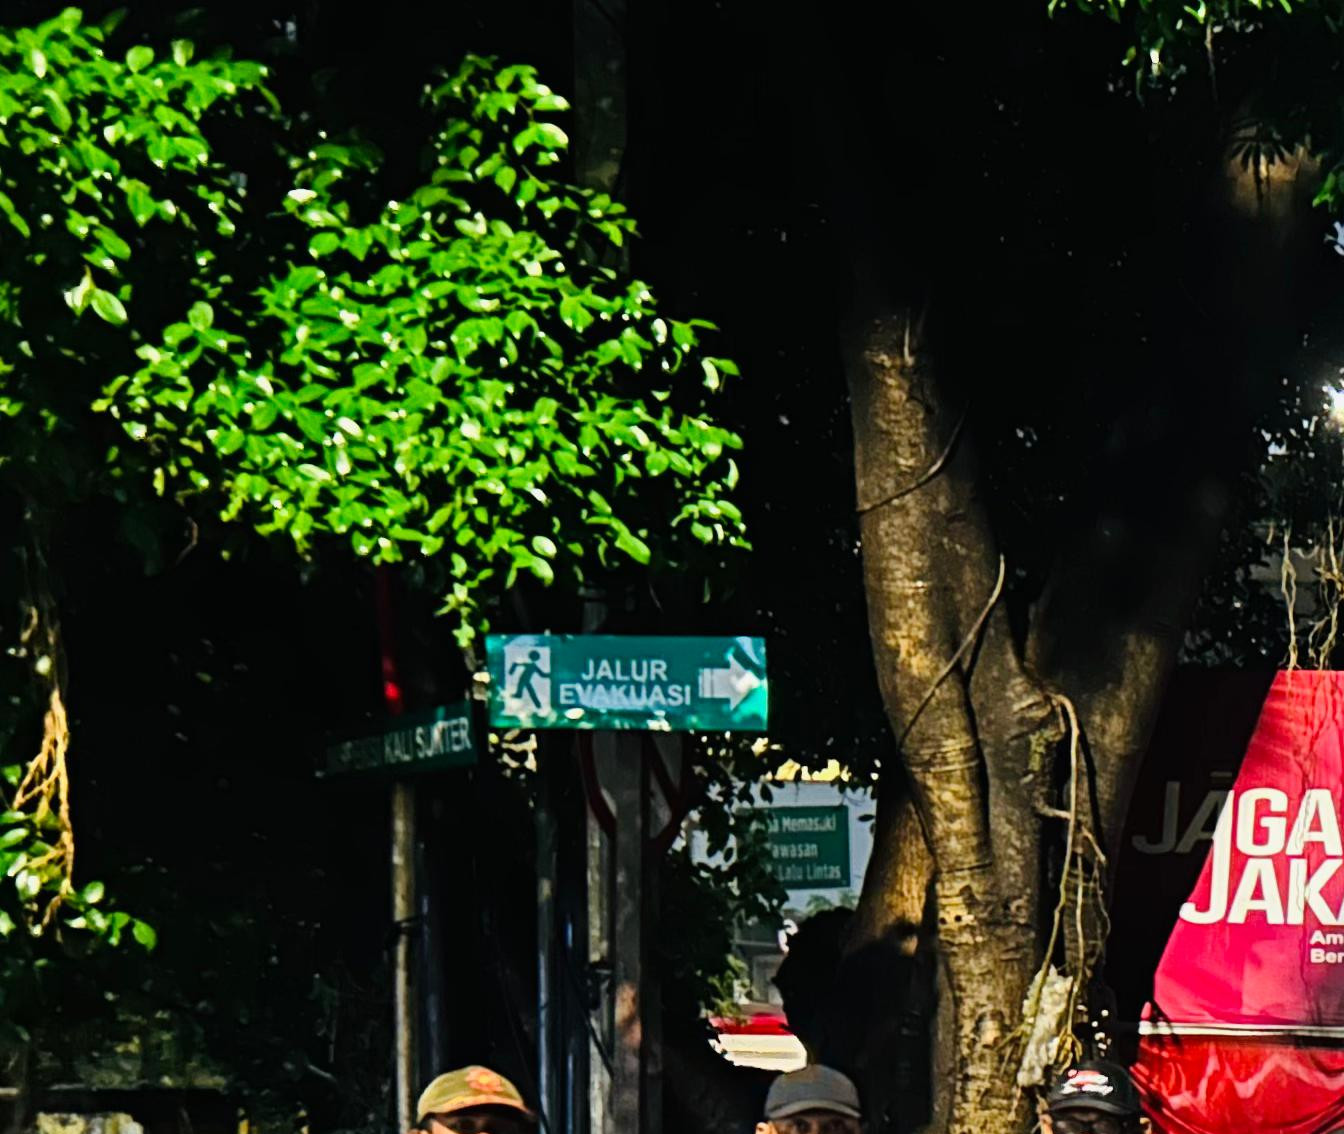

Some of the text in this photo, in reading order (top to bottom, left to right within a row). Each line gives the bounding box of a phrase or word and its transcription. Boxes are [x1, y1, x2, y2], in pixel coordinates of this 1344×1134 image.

[581, 659, 668, 681] JALUR
[559, 684, 691, 706] EVAKUASI
[383, 730, 414, 764] KALI
[806, 863, 842, 880] Lintas
